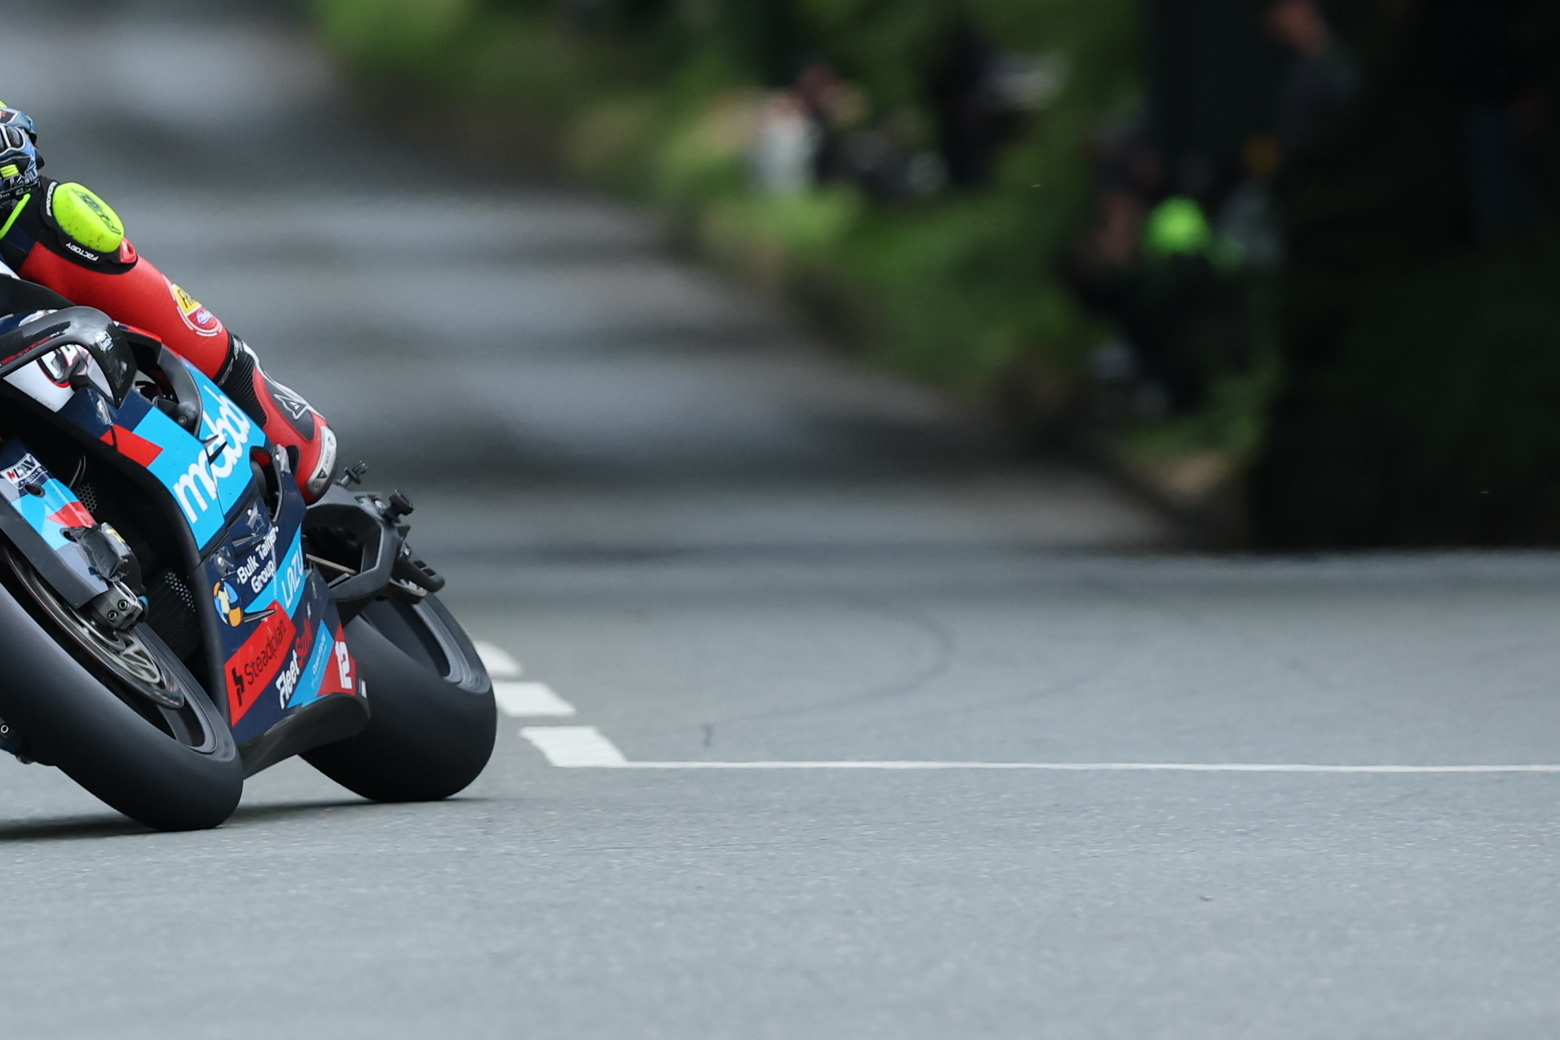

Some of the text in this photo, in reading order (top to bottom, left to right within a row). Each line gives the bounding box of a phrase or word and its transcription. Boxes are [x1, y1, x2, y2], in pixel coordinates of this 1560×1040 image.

[65, 241, 100, 262] FACTORY
[236, 556, 260, 585] Bulk
[250, 560, 276, 594] Group
[243, 620, 288, 686] Steadplan
